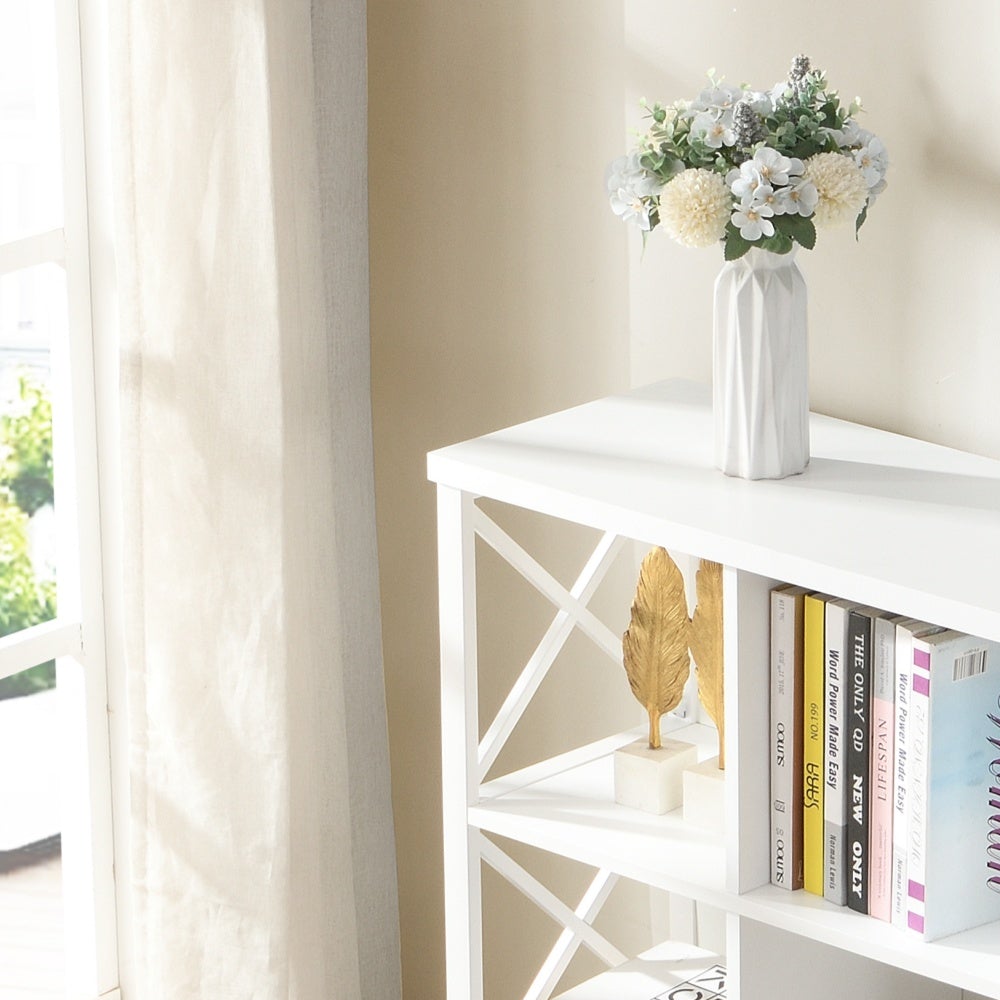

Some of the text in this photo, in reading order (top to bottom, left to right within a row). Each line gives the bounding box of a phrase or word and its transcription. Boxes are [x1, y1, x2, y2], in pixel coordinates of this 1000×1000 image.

[826, 649, 840, 790] Word Power Made Easy
[851, 634, 865, 899] THE ONLY QD NEW ONLY
[877, 718, 887, 801] LIFESPAN
[896, 673, 908, 814] Word Power Made Easy
[828, 834, 837, 890] Norman Lewis
